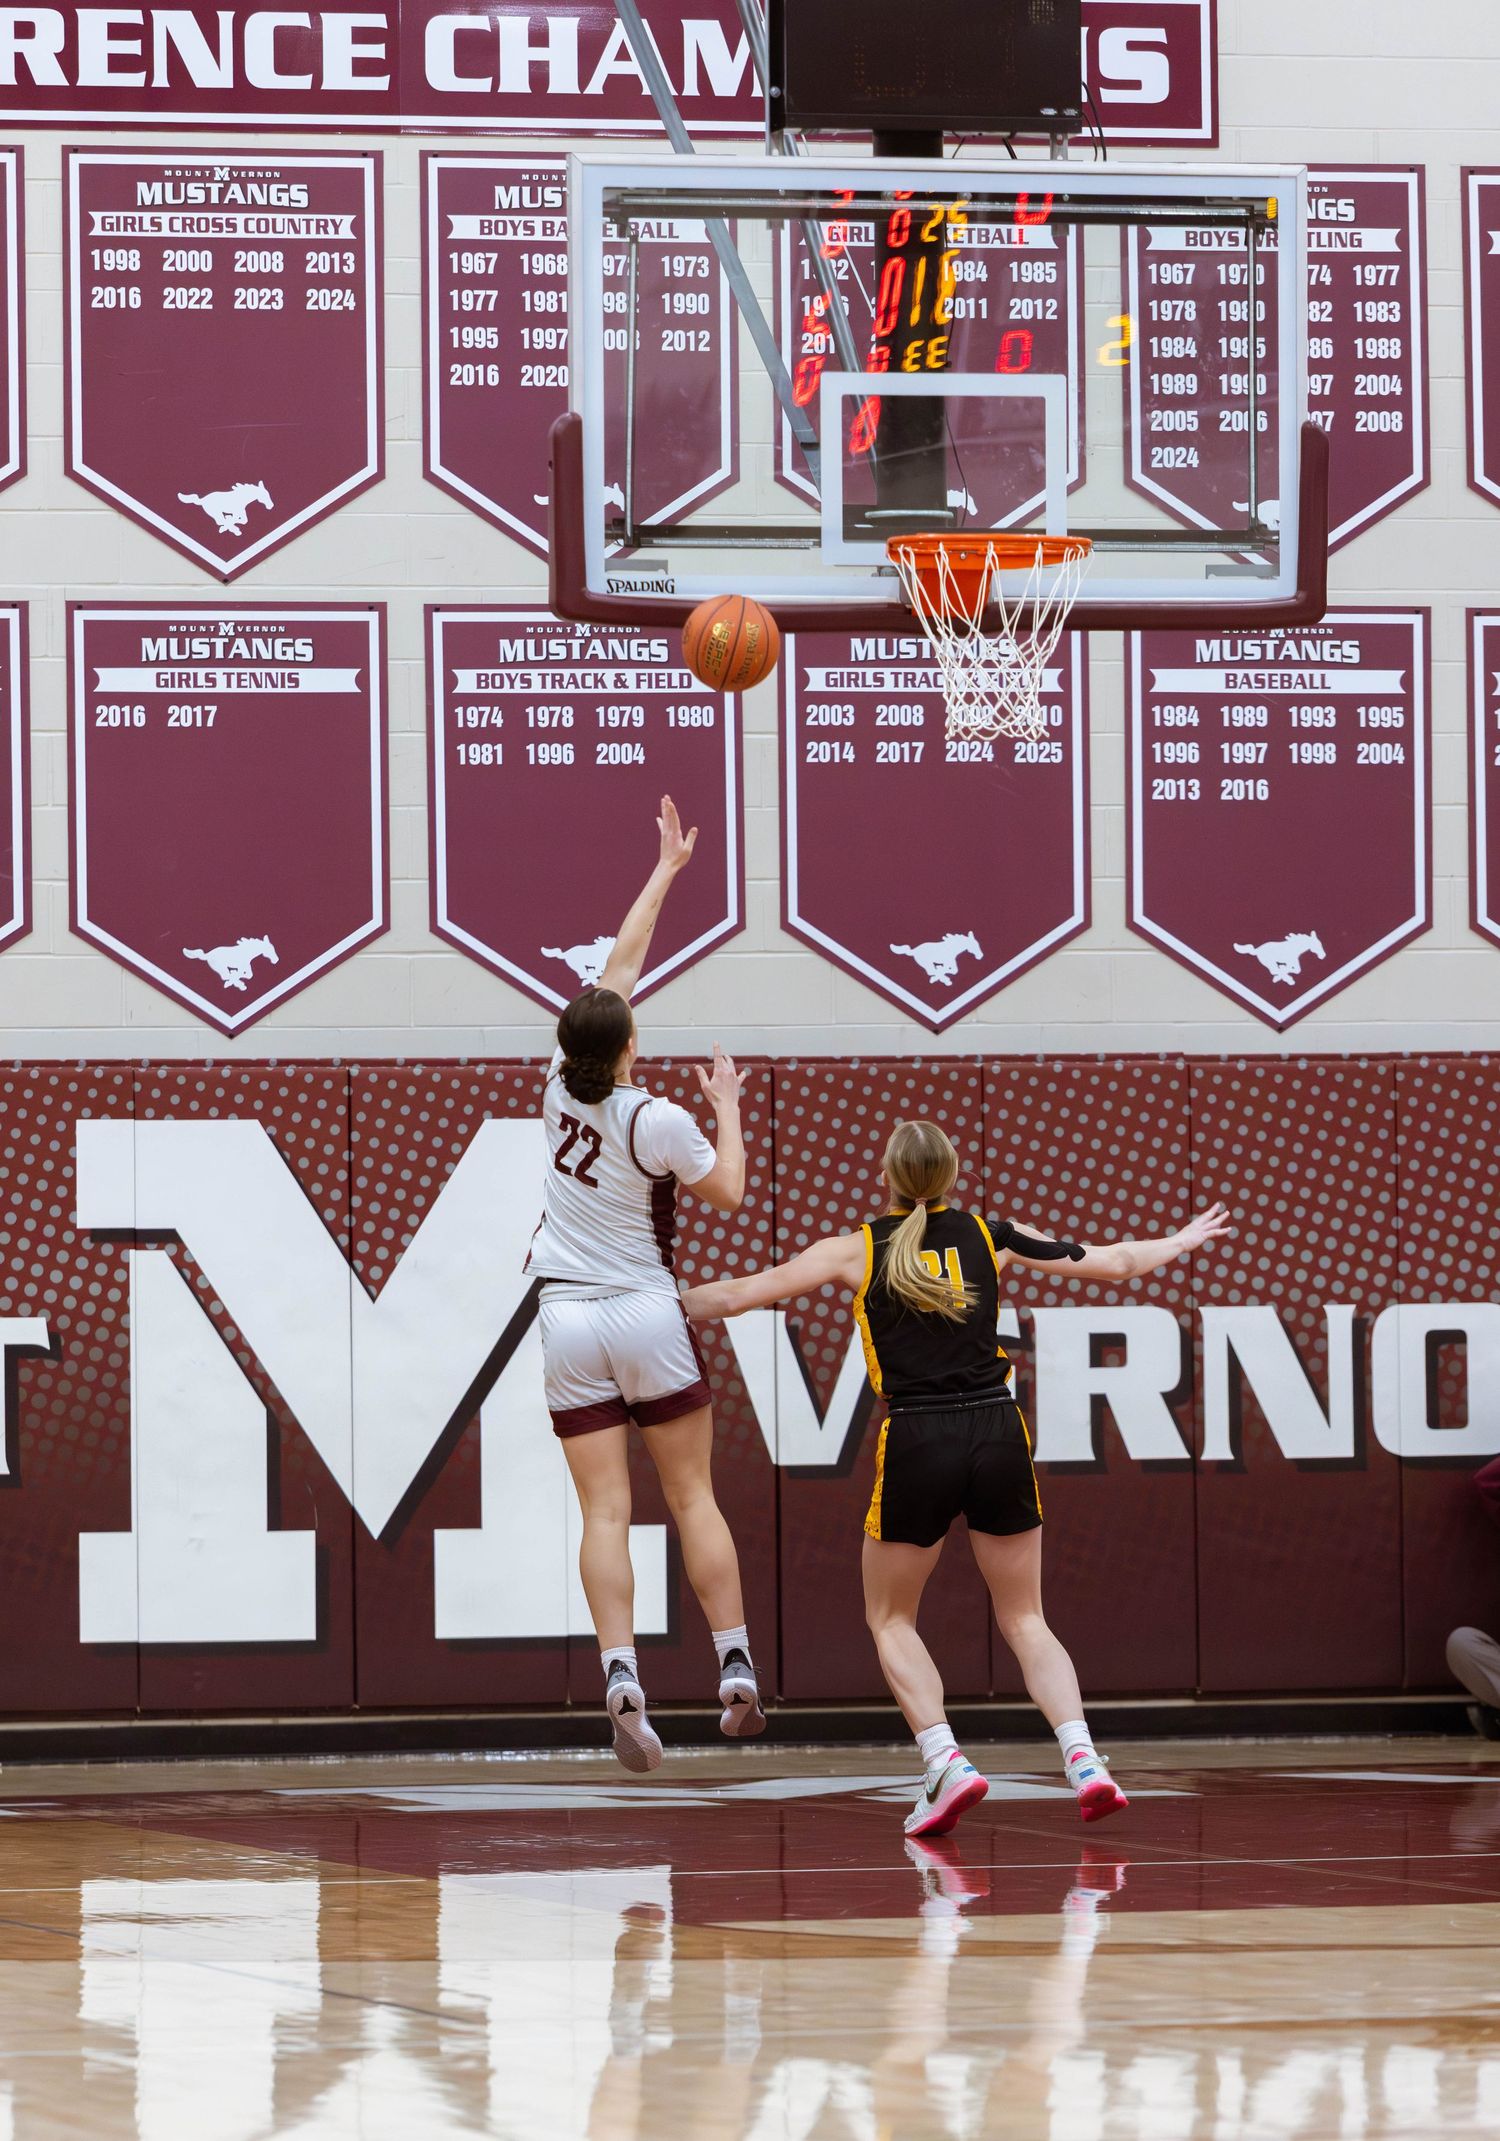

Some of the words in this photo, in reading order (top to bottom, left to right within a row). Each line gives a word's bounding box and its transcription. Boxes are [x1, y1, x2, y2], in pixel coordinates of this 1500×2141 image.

[0, 7, 390, 90] RENCE
[164, 170, 211, 178] MOUNT
[136, 181, 309, 208] MUSTANGS
[101, 216, 162, 233] GIRLS
[168, 217, 238, 234] CROSS
[243, 218, 344, 235] COUNTRY
[479, 219, 535, 237] BOYS
[828, 226, 875, 243] GIRL
[1185, 231, 1240, 248] BOYS
[91, 249, 141, 271] 1998
[162, 250, 213, 272] 2000
[234, 251, 284, 273] 2008
[305, 251, 355, 274] 2013
[449, 252, 498, 274] 1967
[520, 253, 568, 275] 1968
[661, 255, 710, 277] 1973
[1009, 262, 1057, 283] 1985
[1149, 263, 1195, 285] 1967
[1217, 264, 1265, 285] 1970
[1353, 265, 1400, 286] 1977
[91, 287, 141, 309] 2016
[163, 287, 213, 310] 2022
[234, 288, 284, 310] 2023
[306, 289, 356, 311] 2024
[450, 289, 498, 311] 1977
[521, 290, 567, 312] 1981
[661, 293, 710, 315] 1990
[944, 298, 988, 319] 2011
[1009, 298, 1058, 320] 2012
[1149, 300, 1196, 321] 1978
[1354, 301, 1400, 323] 1983
[450, 327, 499, 349] 1995
[520, 328, 568, 350] 1997
[661, 330, 710, 351] 2012
[1150, 337, 1197, 358] 1984
[1354, 338, 1401, 359] 1988
[450, 364, 499, 386] 2016
[520, 365, 569, 387] 2020
[1151, 373, 1198, 395] 1989
[1354, 374, 1402, 396] 2004
[1151, 410, 1198, 432] 2005
[1355, 411, 1403, 432] 2008
[1151, 446, 1199, 468] 2024
[606, 578, 675, 594] SPALDING
[141, 637, 314, 662] MUSTANGS
[499, 638, 669, 663] MUSTANGS
[1195, 639, 1361, 664] MUSTANGS
[155, 671, 217, 688] GIRLS
[223, 671, 300, 688] TENNIS
[476, 673, 532, 690] BOYS
[537, 673, 608, 690] TRACK
[613, 673, 630, 689] &
[635, 673, 693, 689] FIELD
[825, 671, 885, 688] GIRLS
[890, 671, 948, 688] TRAC
[1225, 673, 1331, 690] BASEBALL
[95, 705, 146, 727] 2016
[167, 705, 218, 727] 2017
[454, 706, 503, 728] 1974
[525, 706, 574, 728] 1978
[596, 706, 645, 728] 1979
[665, 706, 714, 727] 1980
[806, 704, 855, 726] 2003
[876, 704, 925, 726] 2008
[1151, 705, 1199, 727] 1984
[1220, 705, 1268, 728] 1989
[1289, 706, 1336, 728] 1993
[1357, 706, 1404, 728] 1995
[456, 743, 503, 765] 1981
[526, 743, 575, 765] 1996
[596, 743, 645, 765] 2004
[806, 741, 855, 763] 2014
[876, 741, 925, 763] 2017
[945, 741, 994, 763] 2024
[1014, 741, 1063, 763] 2025
[1152, 742, 1200, 764] 1996
[1220, 742, 1268, 764] 1997
[1289, 742, 1337, 764] 1998
[1357, 743, 1405, 764] 2004
[1152, 779, 1200, 800] 2013
[1220, 779, 1269, 801] 2016
[554, 1112, 603, 1189] 22
[76, 1119, 667, 1643] M
[723, 1302, 1500, 1467] VRNO
